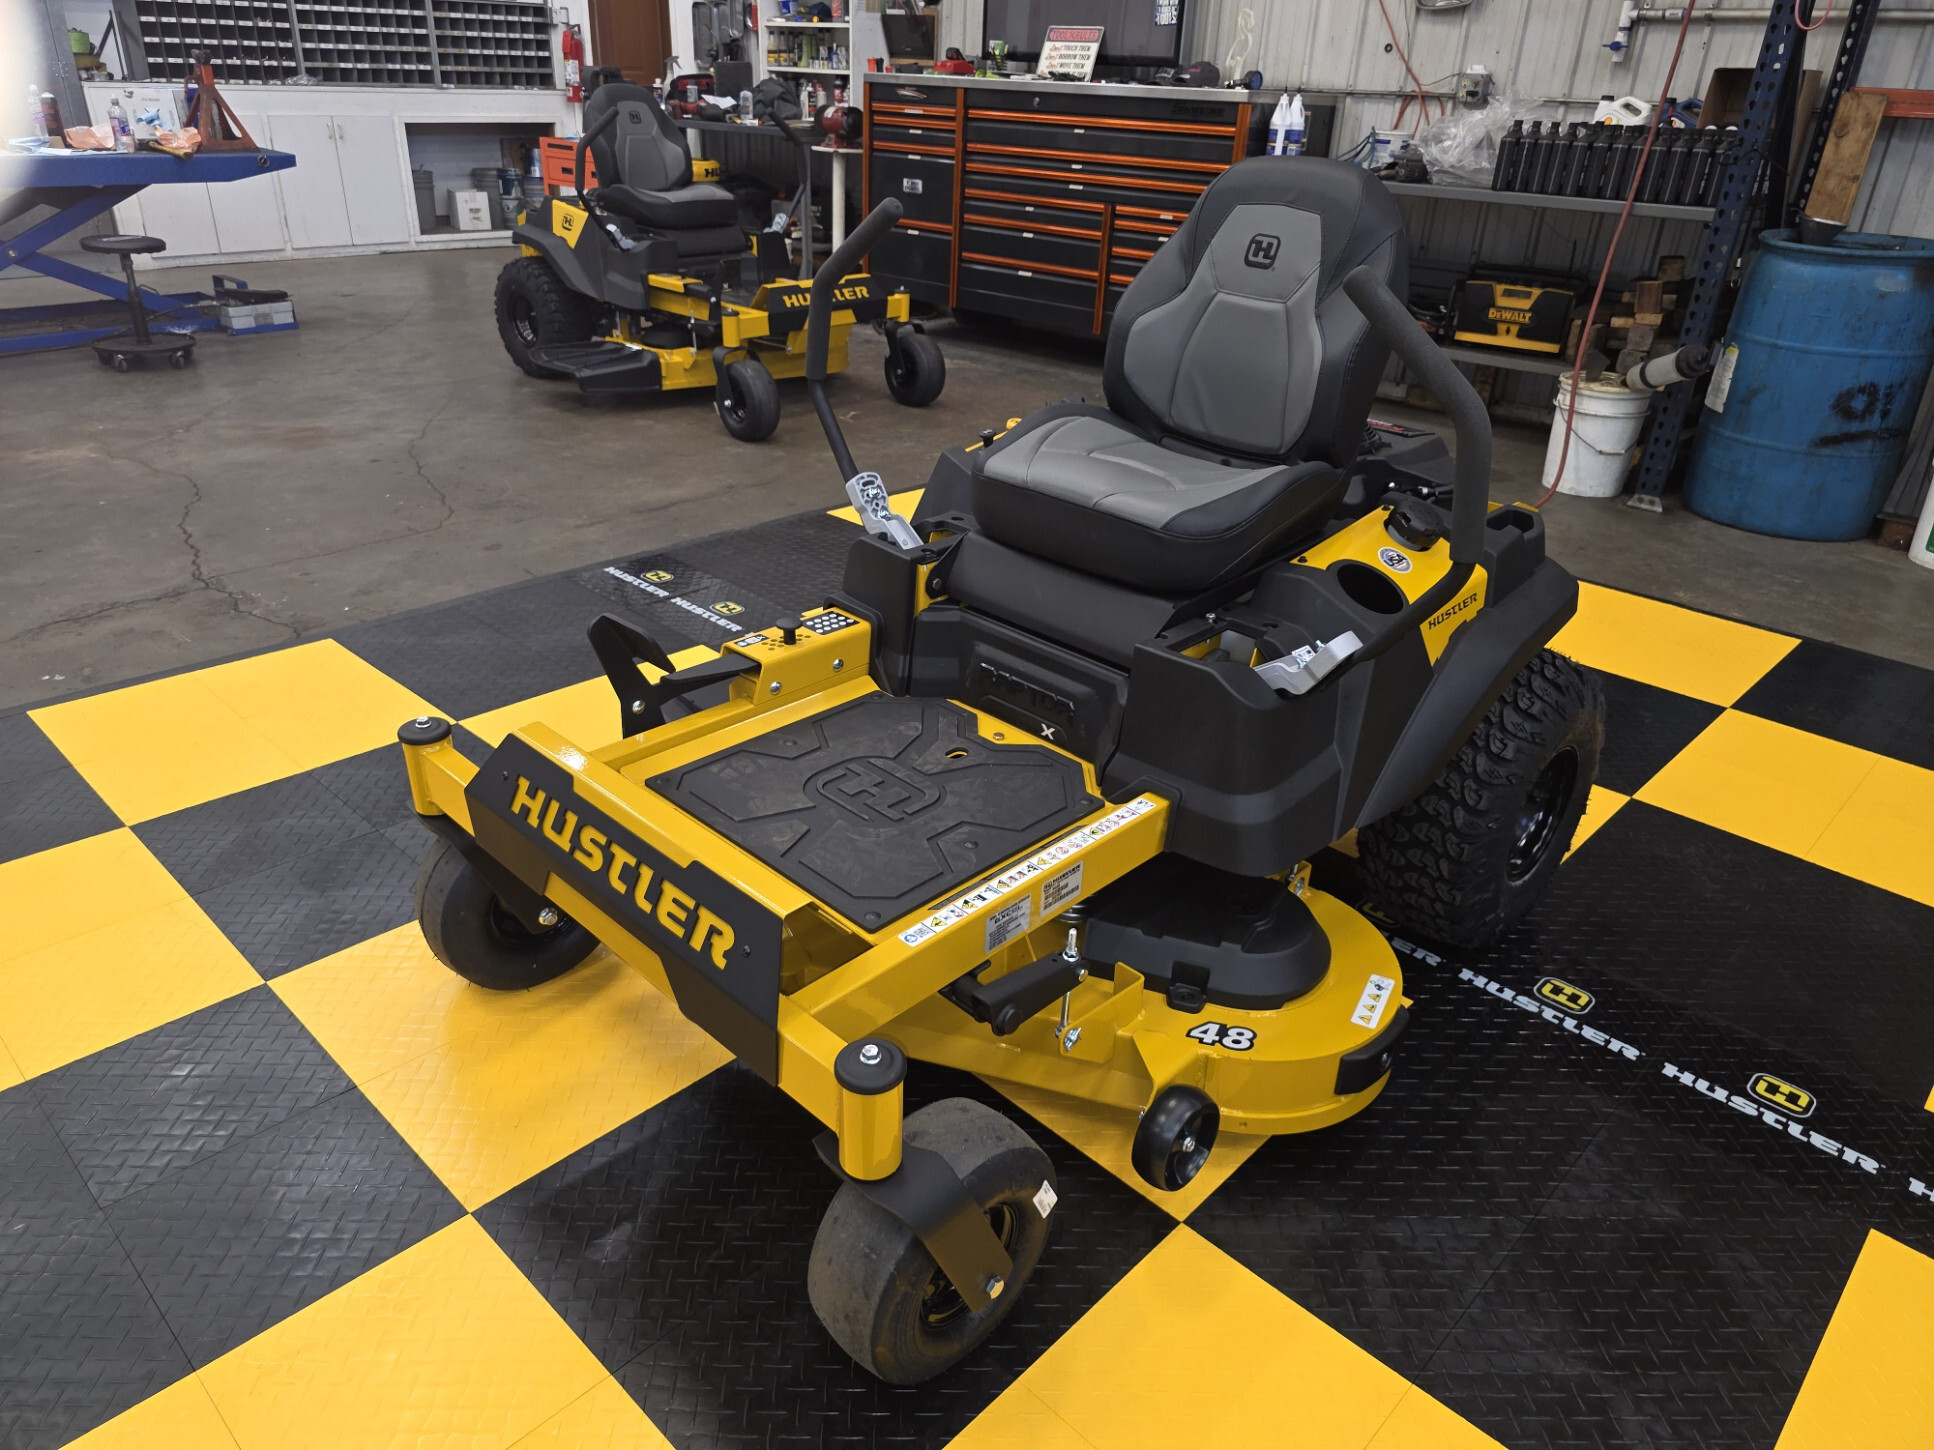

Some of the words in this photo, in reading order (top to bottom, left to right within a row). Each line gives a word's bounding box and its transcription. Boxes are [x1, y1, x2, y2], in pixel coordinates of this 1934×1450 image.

[782, 286, 870, 308] HULER
[603, 566, 670, 597] HUSTLER
[670, 596, 743, 632] HUSTLER
[1428, 592, 1478, 630] HUSTLER
[510, 776, 736, 971] HUSTLER
[1458, 967, 1641, 1061] HUSTLER
[1187, 1021, 1256, 1050] 48
[1661, 1062, 1880, 1175] HUSTLER
